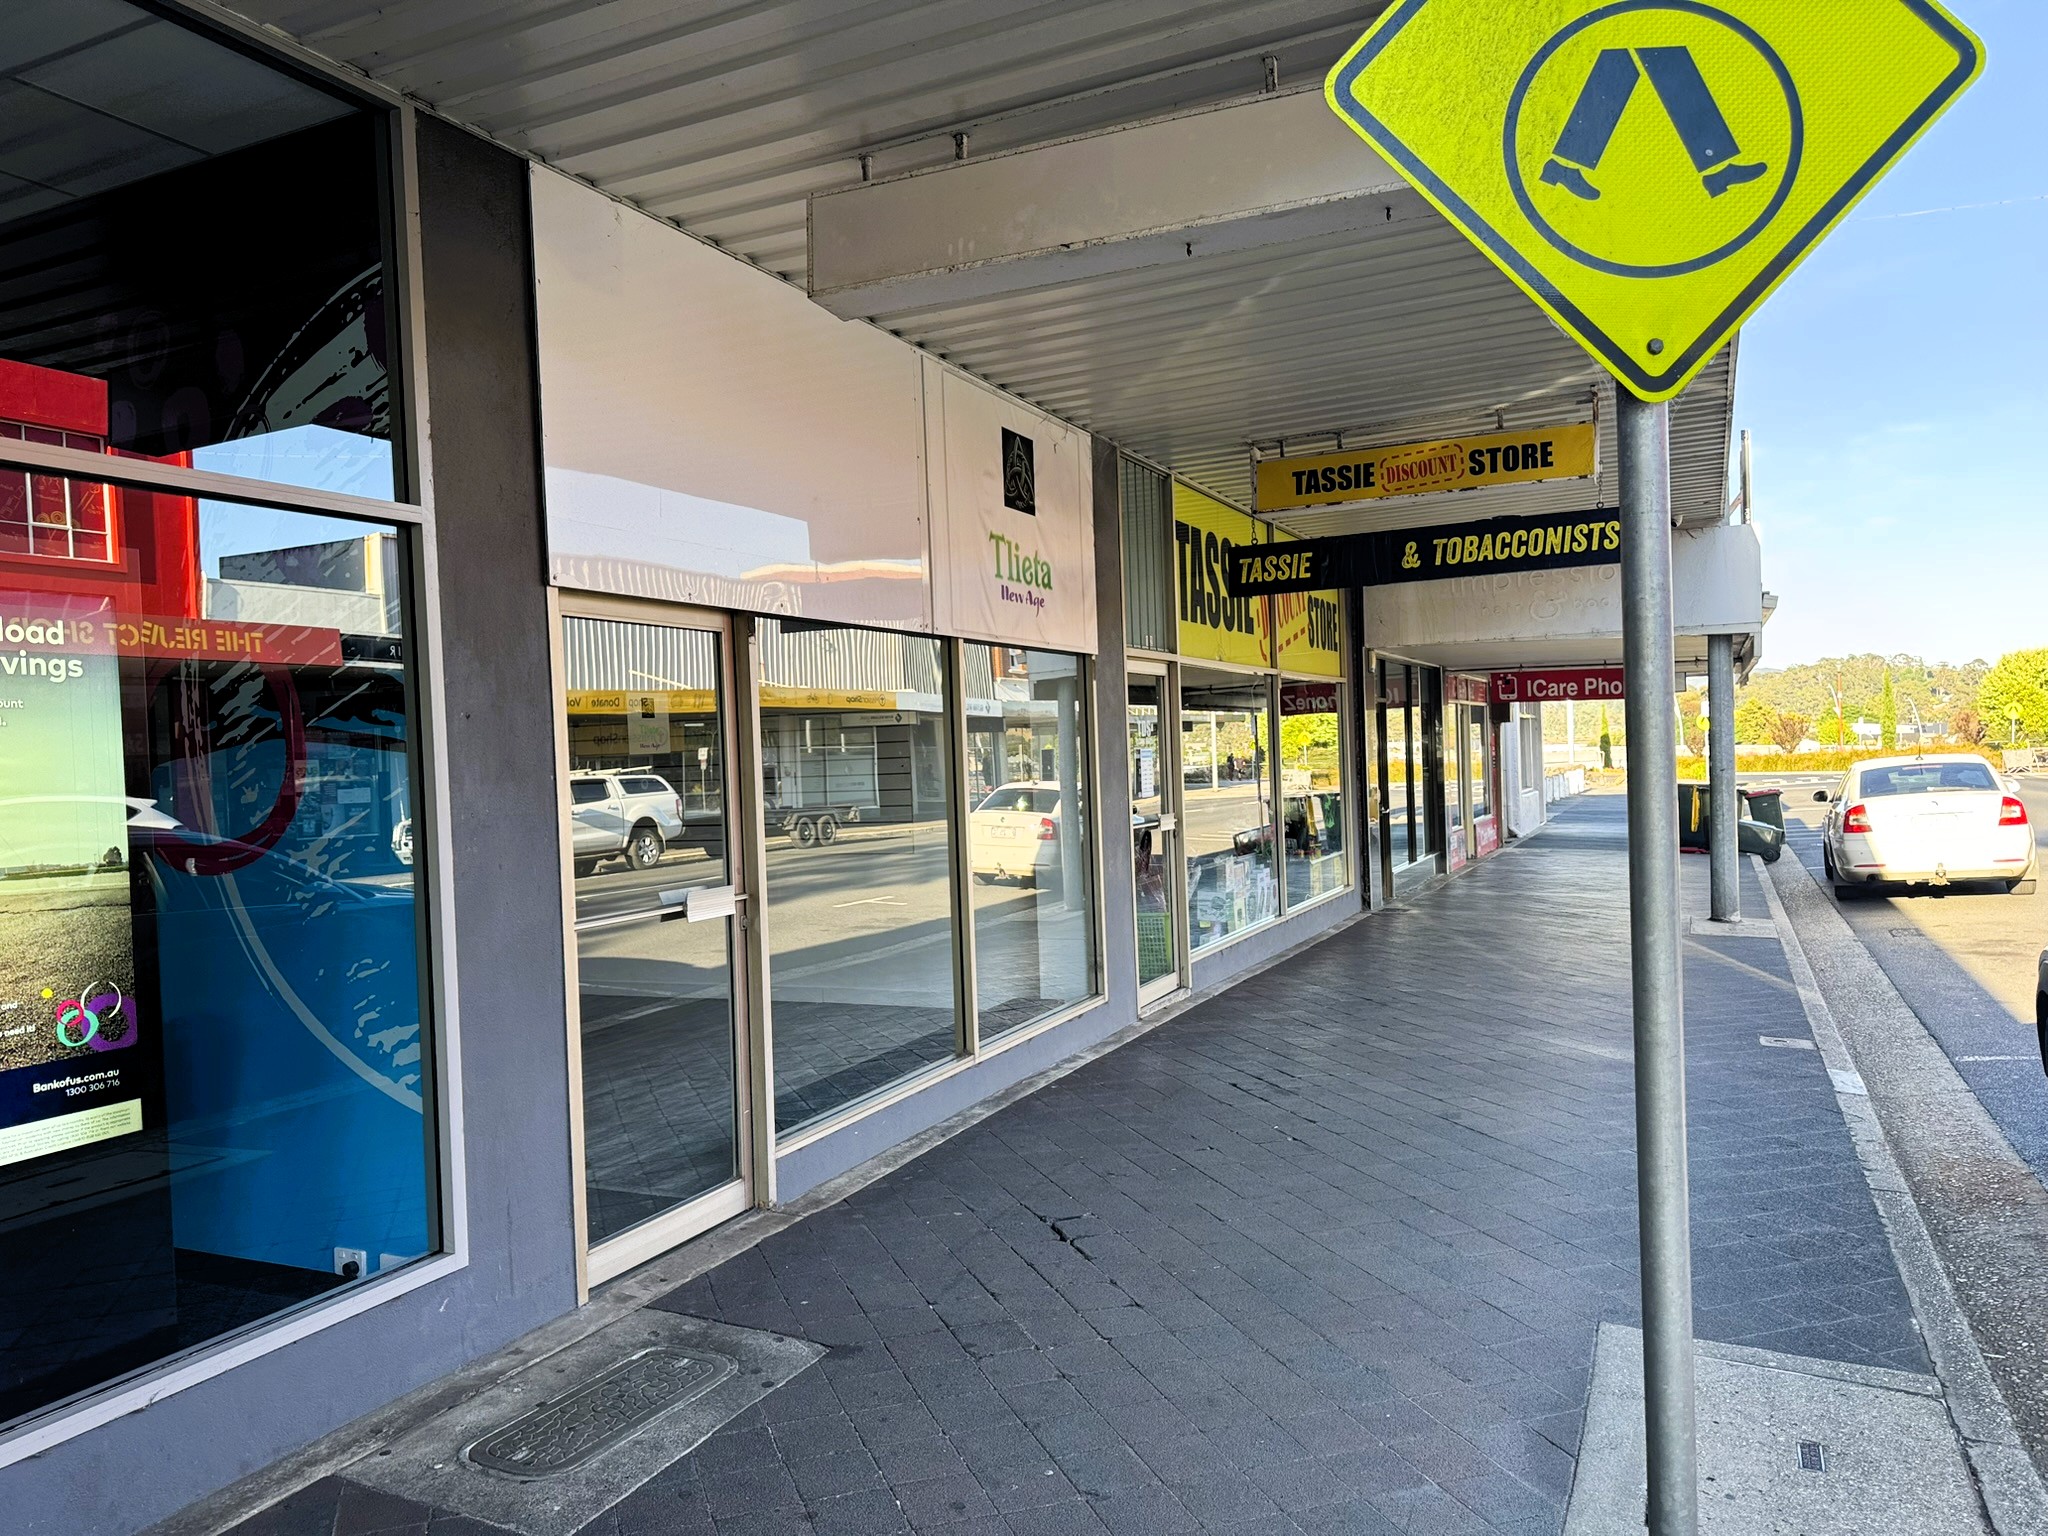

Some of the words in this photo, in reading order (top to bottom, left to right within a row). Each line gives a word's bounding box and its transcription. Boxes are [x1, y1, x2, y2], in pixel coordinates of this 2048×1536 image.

[1292, 461, 1375, 496] TASSIE
[1385, 454, 1457, 486] DISCOUNT
[1468, 441, 1554, 476] STORE
[989, 529, 1053, 590] Tlieta
[1238, 552, 1313, 584] TASSIE
[1400, 541, 1421, 569] &
[1433, 520, 1621, 566] TOBACCONISTS
[1001, 585, 1024, 604] New
[1025, 590, 1045, 618] Age
[1307, 594, 1338, 652] STORE
[1526, 679, 1579, 697] ICare
[32, 1069, 120, 1093] Bankofus.com.au
[65, 1085, 87, 1097] 1300
[88, 1082, 105, 1092] 306
[106, 1078, 120, 1088] 716
